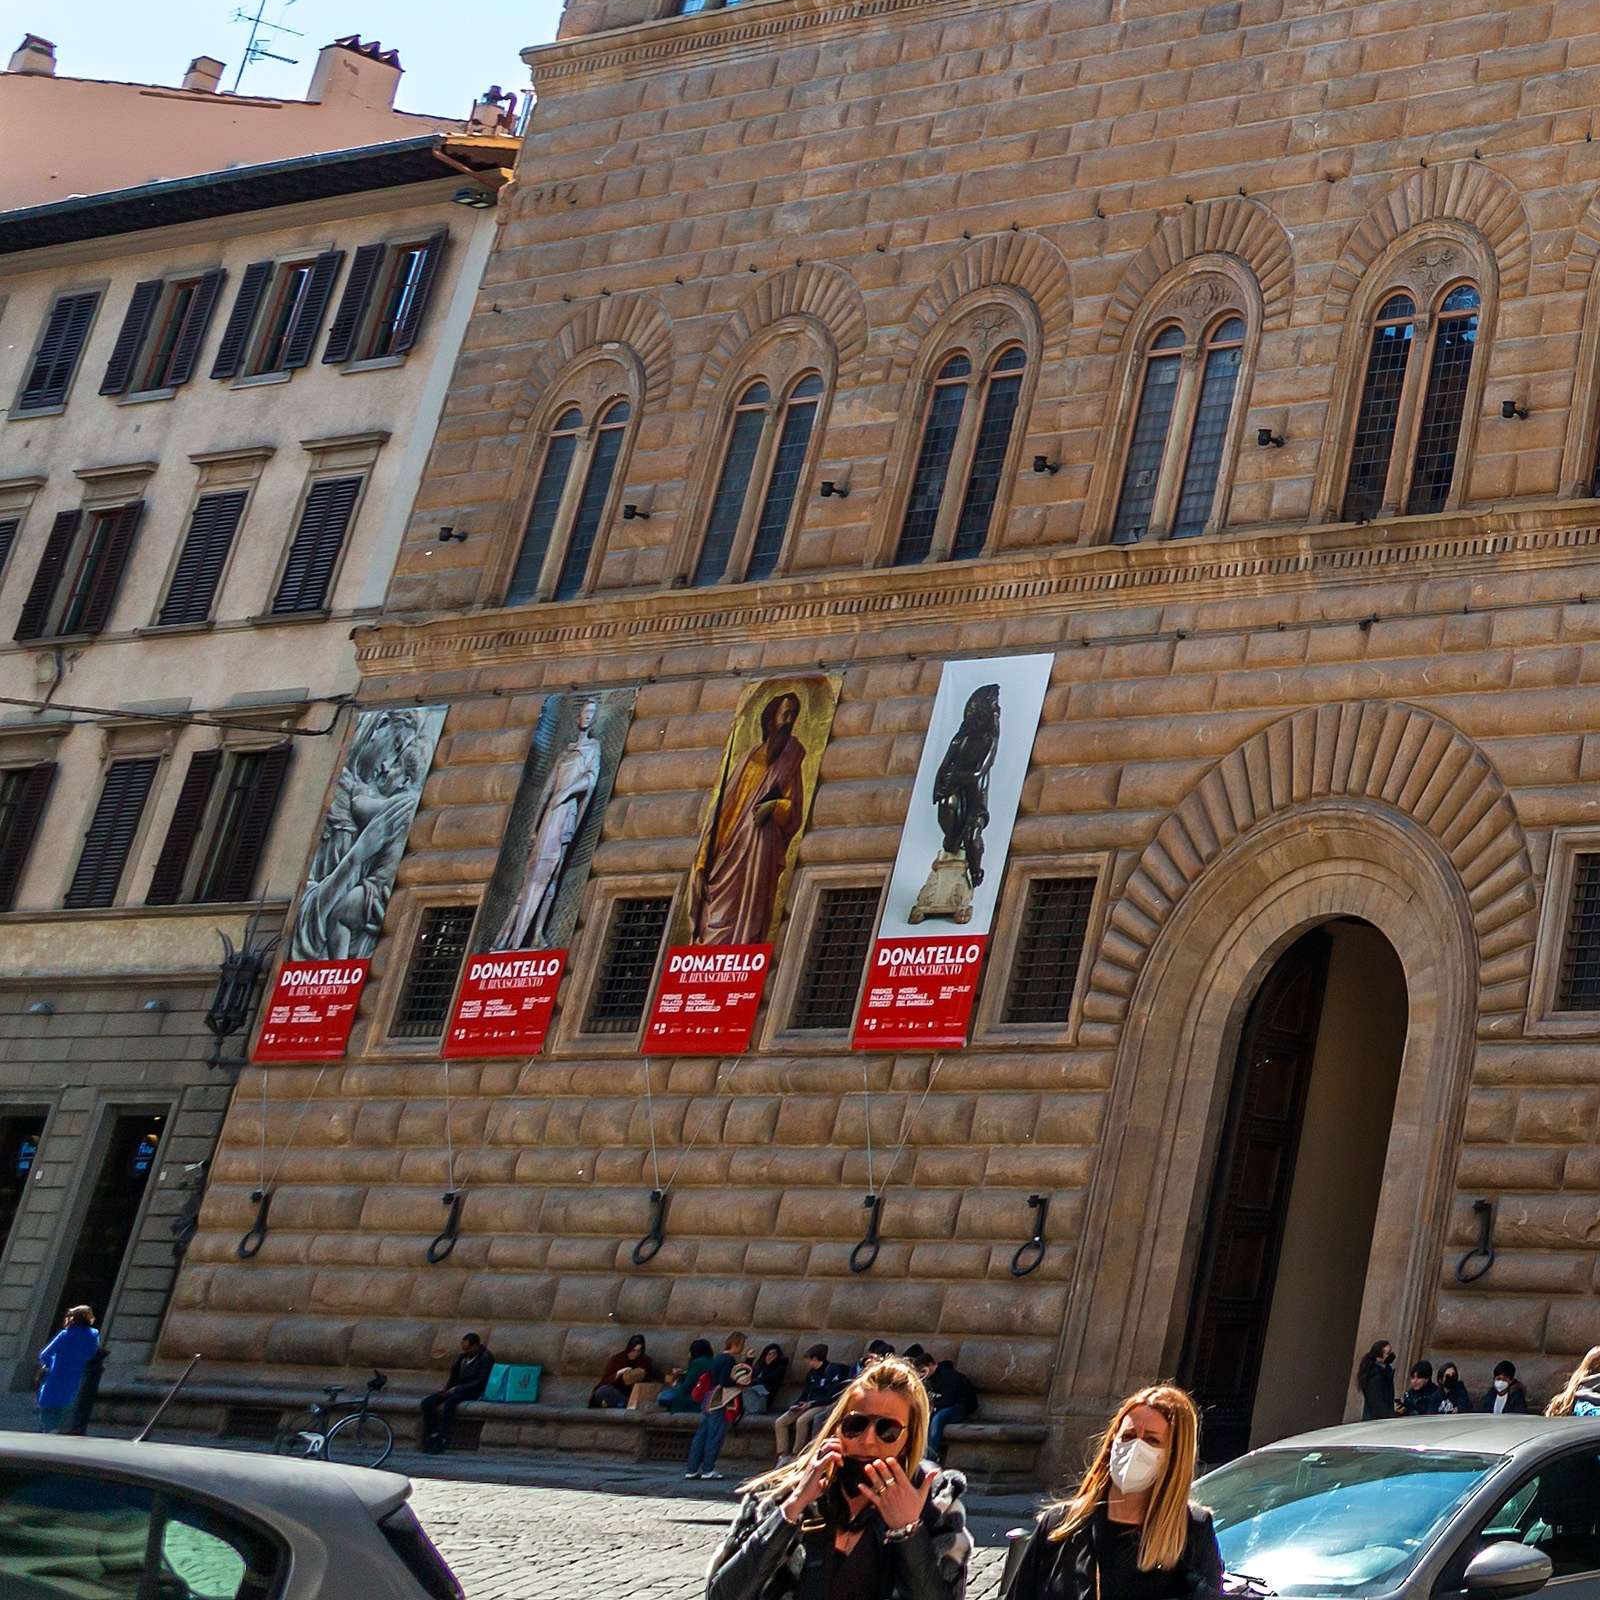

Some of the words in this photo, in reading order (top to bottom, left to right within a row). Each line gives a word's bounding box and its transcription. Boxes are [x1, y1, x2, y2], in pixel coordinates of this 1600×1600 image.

[669, 954, 765, 972] DONATELLO
[878, 945, 980, 965] DONATELLO
[280, 968, 363, 986] DONATELLO
[470, 959, 560, 980] DONATELLO
[679, 972, 689, 983] IL
[689, 972, 748, 983] RINASCIMENTO
[889, 965, 899, 977] IL
[899, 964, 961, 977] RINASCIMENTO
